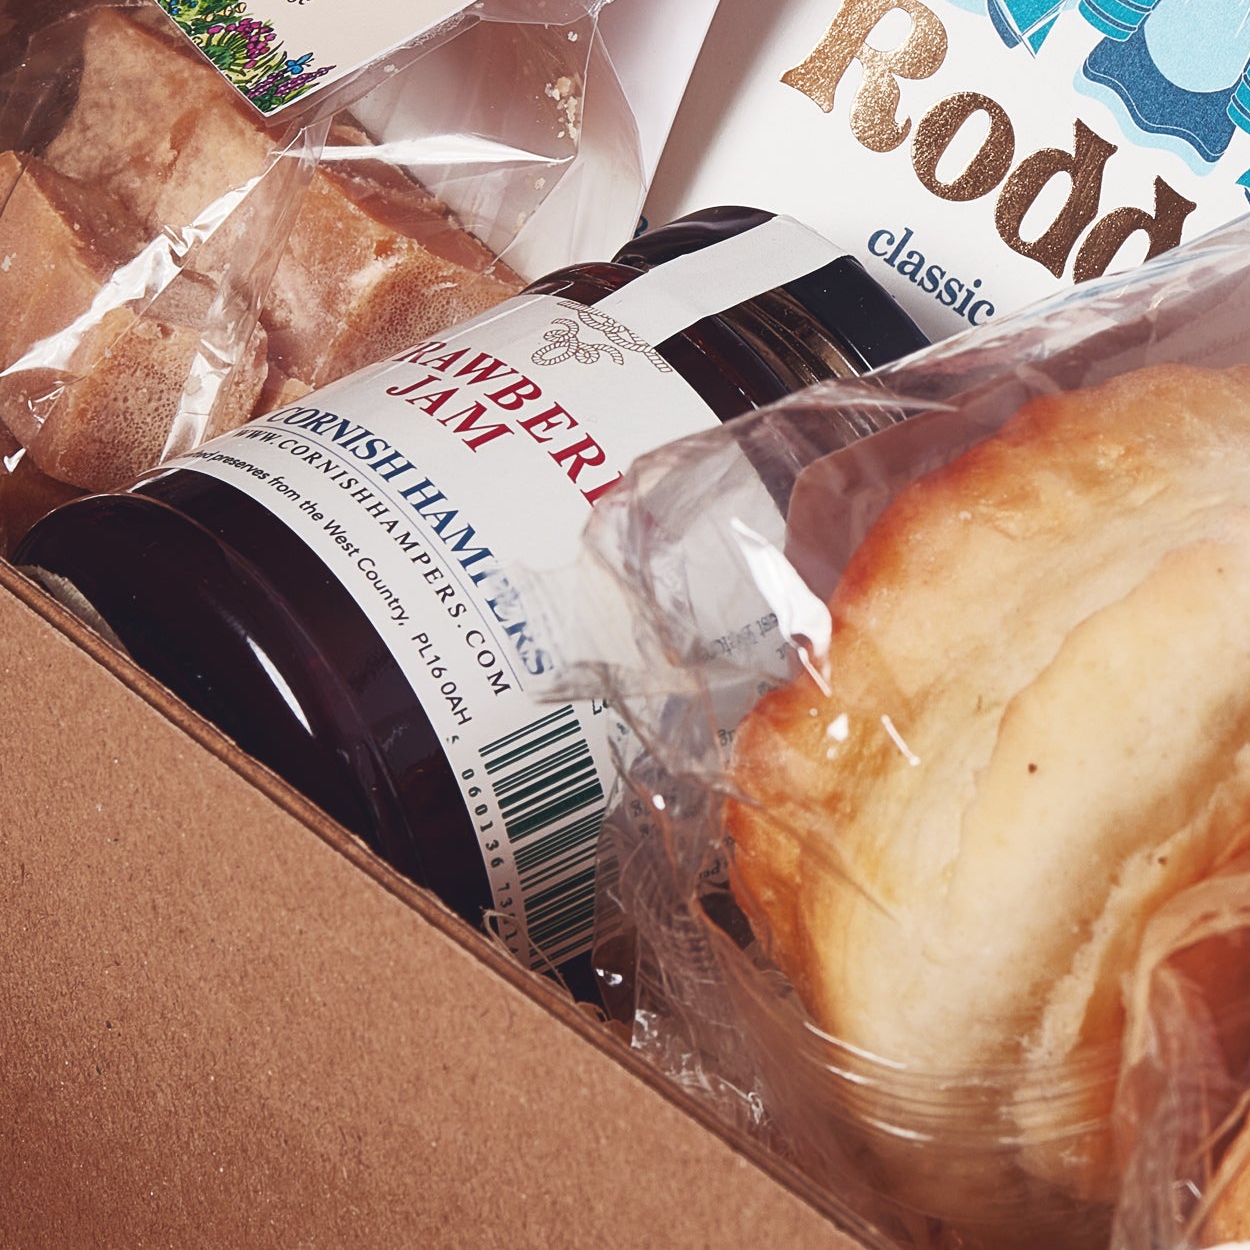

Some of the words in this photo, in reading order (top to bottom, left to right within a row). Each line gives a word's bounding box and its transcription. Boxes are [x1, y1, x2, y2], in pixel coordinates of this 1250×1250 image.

[867, 227, 995, 327] classic
[267, 406, 417, 484] CORNISH
[385, 374, 515, 454] JAM
[206, 453, 270, 480] preserves
[267, 476, 300, 502] from
[298, 499, 325, 522] the
[322, 519, 360, 557] West
[357, 556, 410, 626] Country,
[411, 631, 447, 679] PL16
[233, 429, 512, 697] WWW.CORNISHHAMPERS.COM
